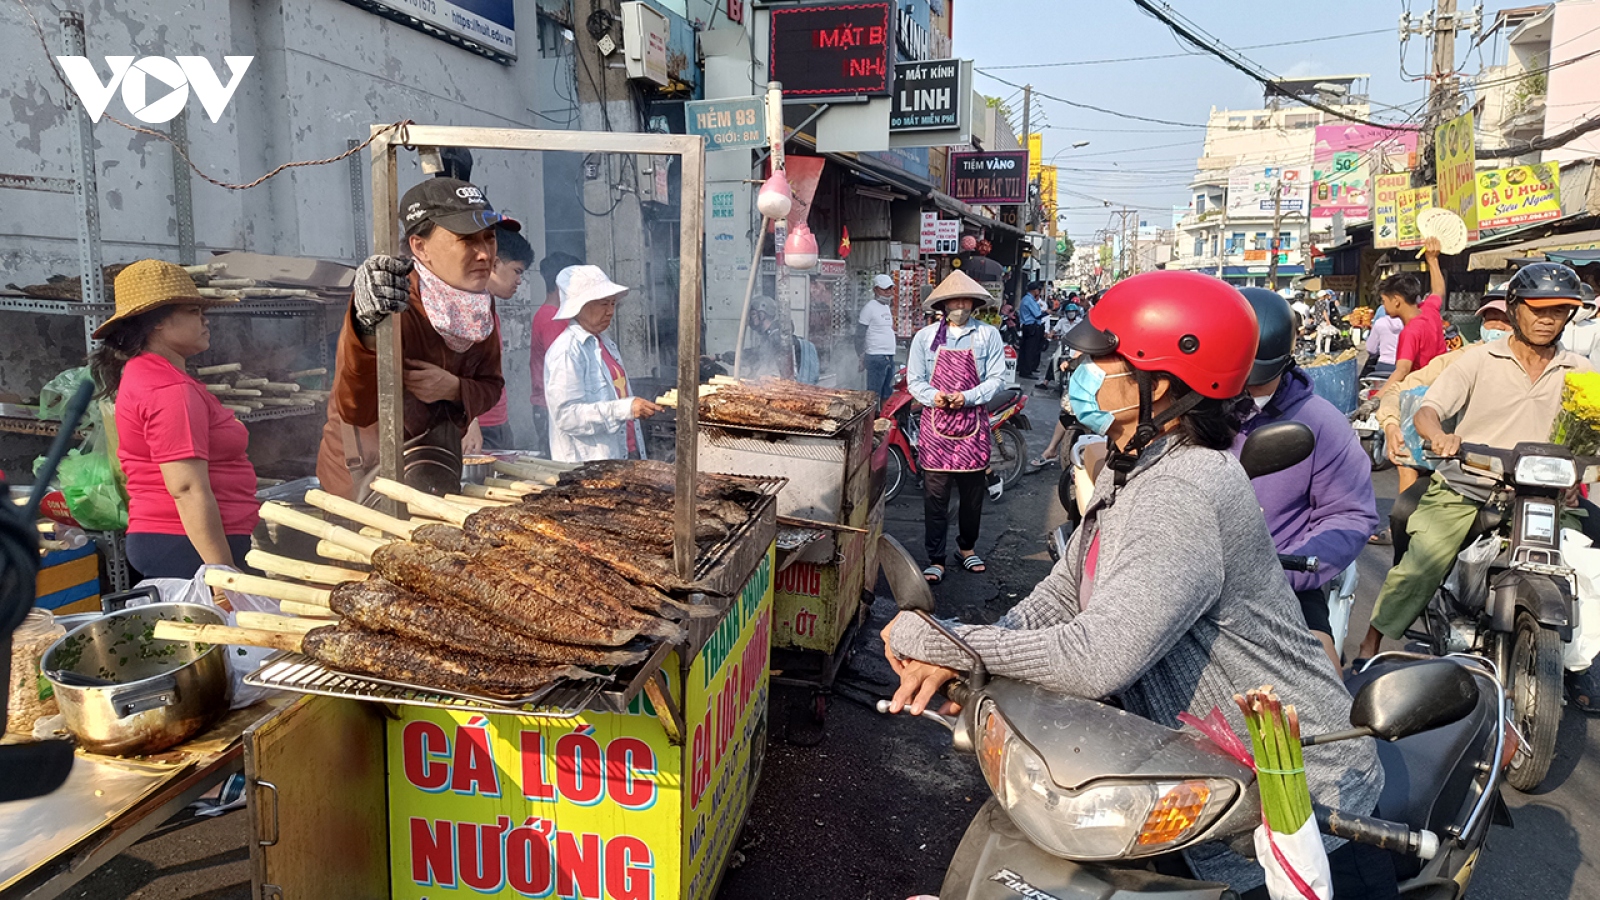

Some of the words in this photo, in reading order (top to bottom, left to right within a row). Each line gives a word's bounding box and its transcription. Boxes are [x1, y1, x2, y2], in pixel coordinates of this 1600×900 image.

[906, 65, 928, 80] MẮT
[930, 65, 955, 79] KÍNH
[900, 87, 950, 112] LINH
[696, 106, 731, 129] HẺM
[735, 108, 756, 126] 93
[714, 130, 740, 144] GIỚI:
[743, 130, 759, 141] 8M
[963, 159, 983, 173] TIỆM
[986, 157, 1015, 170] VÀNG
[956, 178, 975, 197] KIM
[977, 172, 1002, 197] PHÁT
[1005, 178, 1020, 197] VII
[1378, 190, 1397, 202] QU
[1481, 190, 1500, 207] GÀ
[1504, 184, 1514, 200] Ủ
[702, 598, 740, 690] THANH
[690, 693, 712, 811] CÁ
[716, 663, 739, 771] LÓC
[402, 715, 502, 797] CÁ
[520, 723, 658, 811] LÓC
[409, 815, 655, 900] NƯỚNG
[989, 868, 1062, 900] Futur
